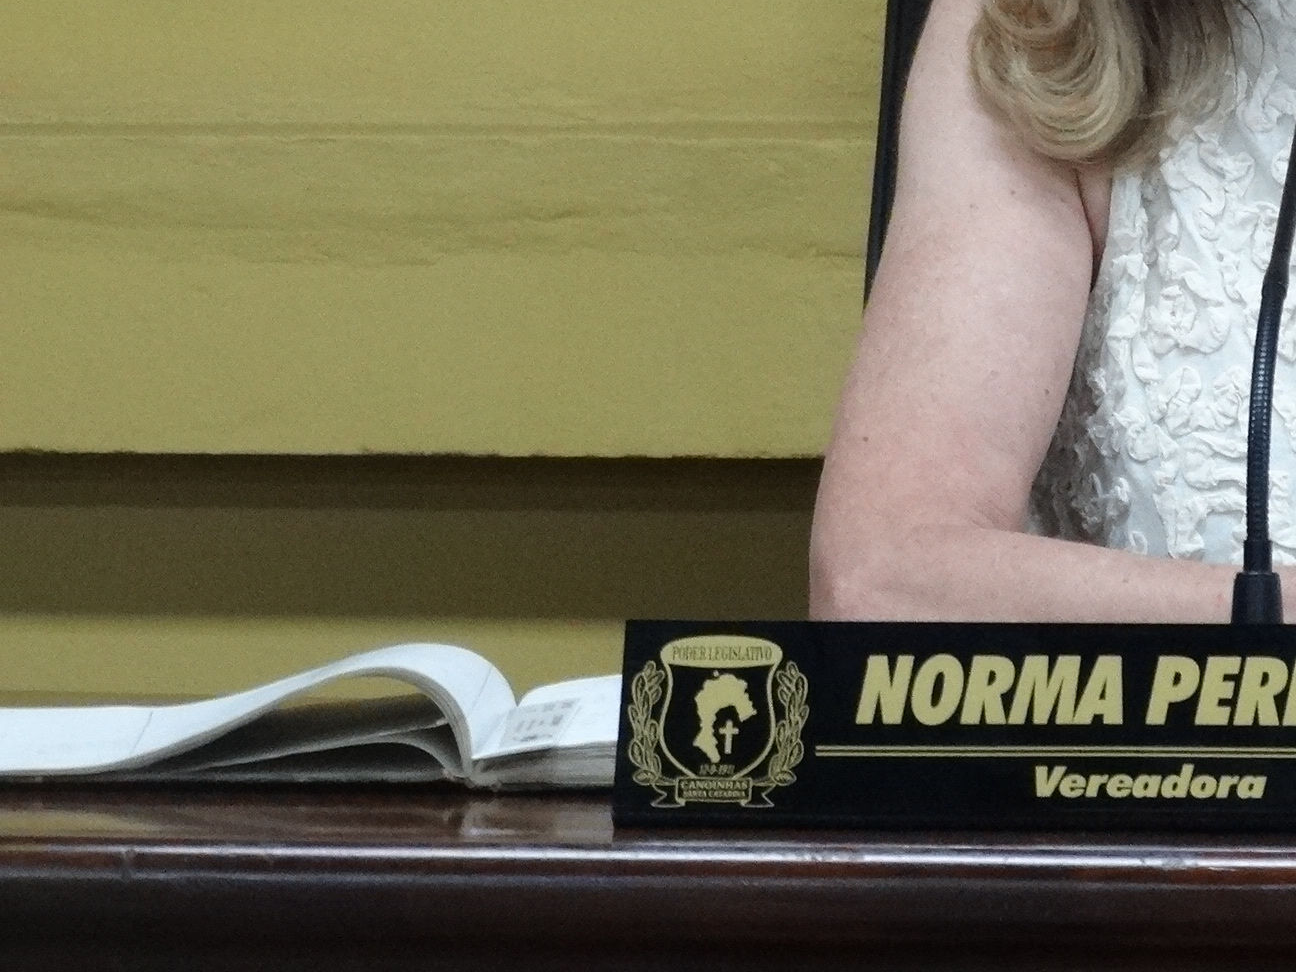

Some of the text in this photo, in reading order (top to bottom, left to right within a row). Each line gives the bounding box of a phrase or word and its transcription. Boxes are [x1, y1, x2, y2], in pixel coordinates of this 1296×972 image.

[673, 645, 773, 661] PODER LEGISLATIVO
[856, 654, 1123, 726] NORMA
[1034, 764, 1266, 799] Vereadora
